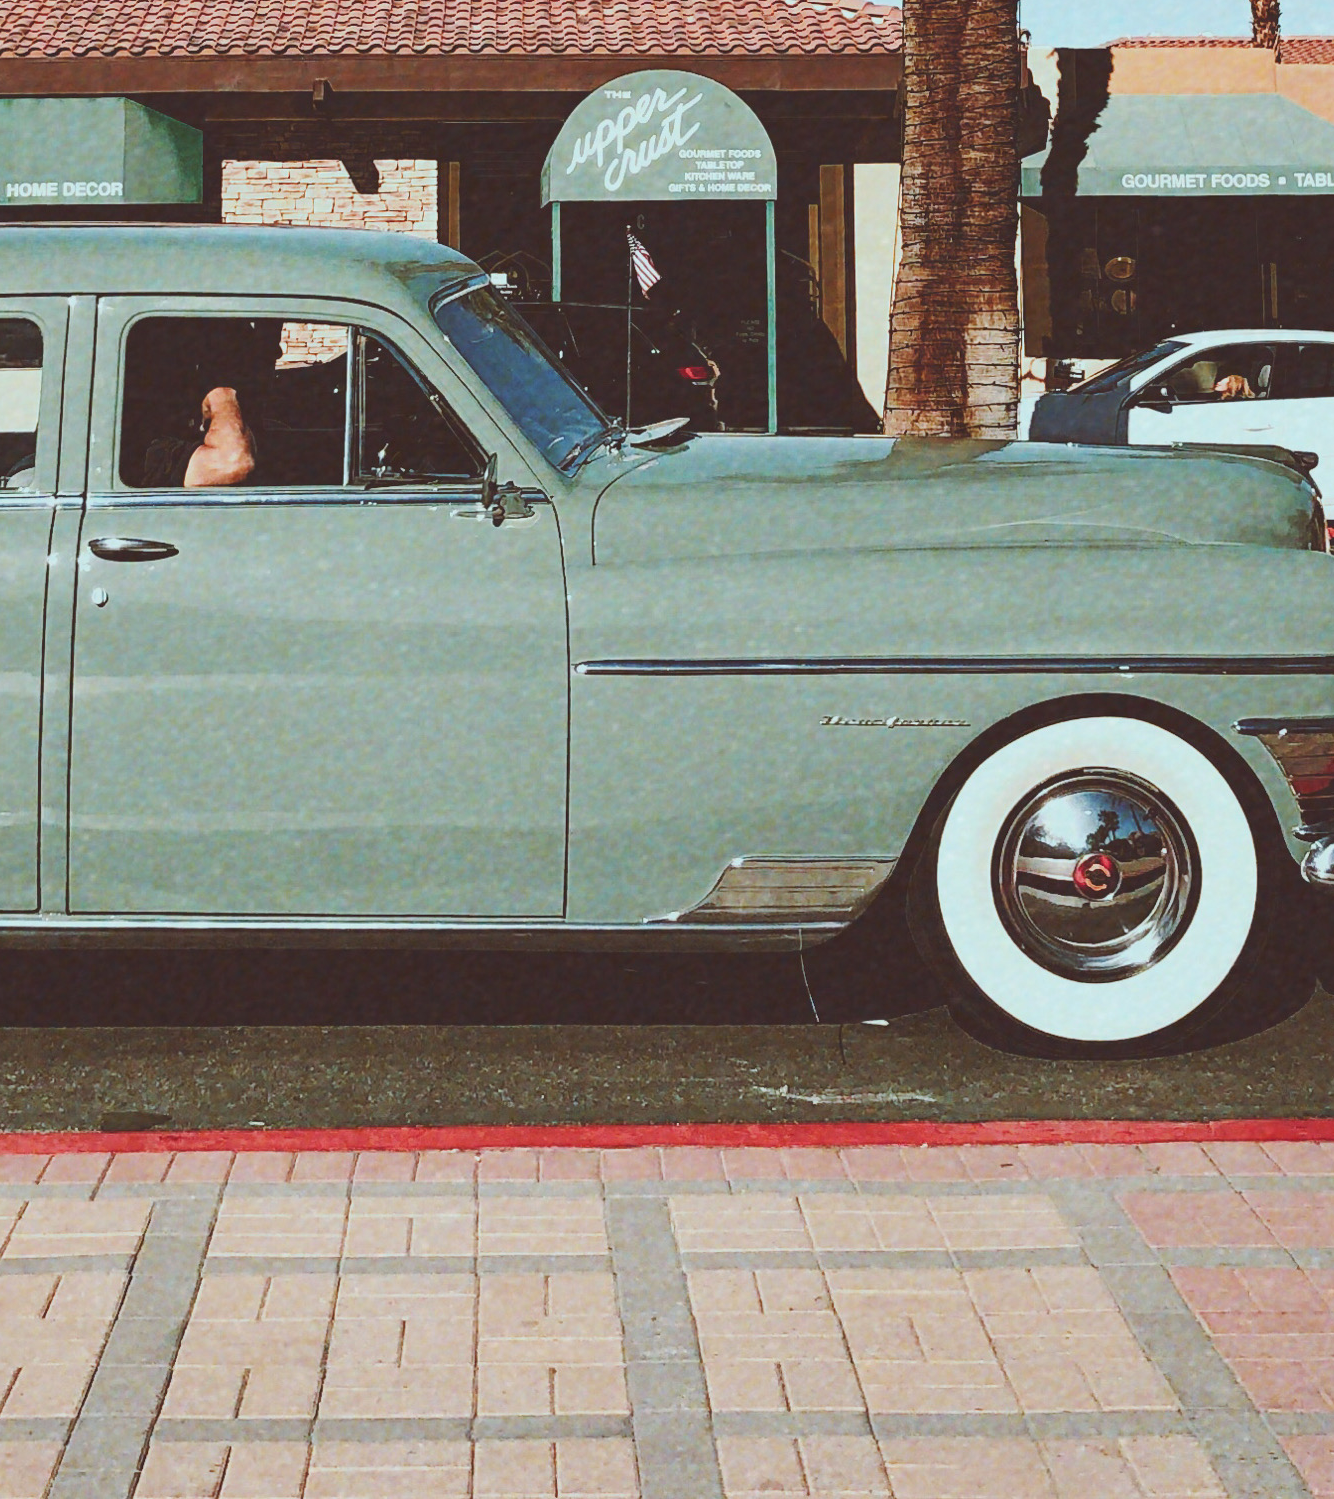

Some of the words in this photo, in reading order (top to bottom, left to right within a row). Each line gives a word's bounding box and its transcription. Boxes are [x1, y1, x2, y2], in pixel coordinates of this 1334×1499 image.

[604, 90, 631, 99] THE
[566, 87, 688, 175] upper
[604, 92, 704, 192] crust
[679, 150, 727, 159] GOURMET
[729, 150, 762, 159] FOODS
[695, 161, 745, 170] TABLETOP
[684, 172, 725, 181] KITCHEN
[727, 172, 756, 181] WARE
[1122, 174, 1207, 189] GOURMET
[1211, 173, 1270, 188] FOODS
[6, 182, 58, 198] HOME
[63, 181, 123, 197] DECOR
[668, 184, 696, 192] GIFTS
[708, 184, 736, 192] HOME
[737, 184, 772, 192] DECOR
